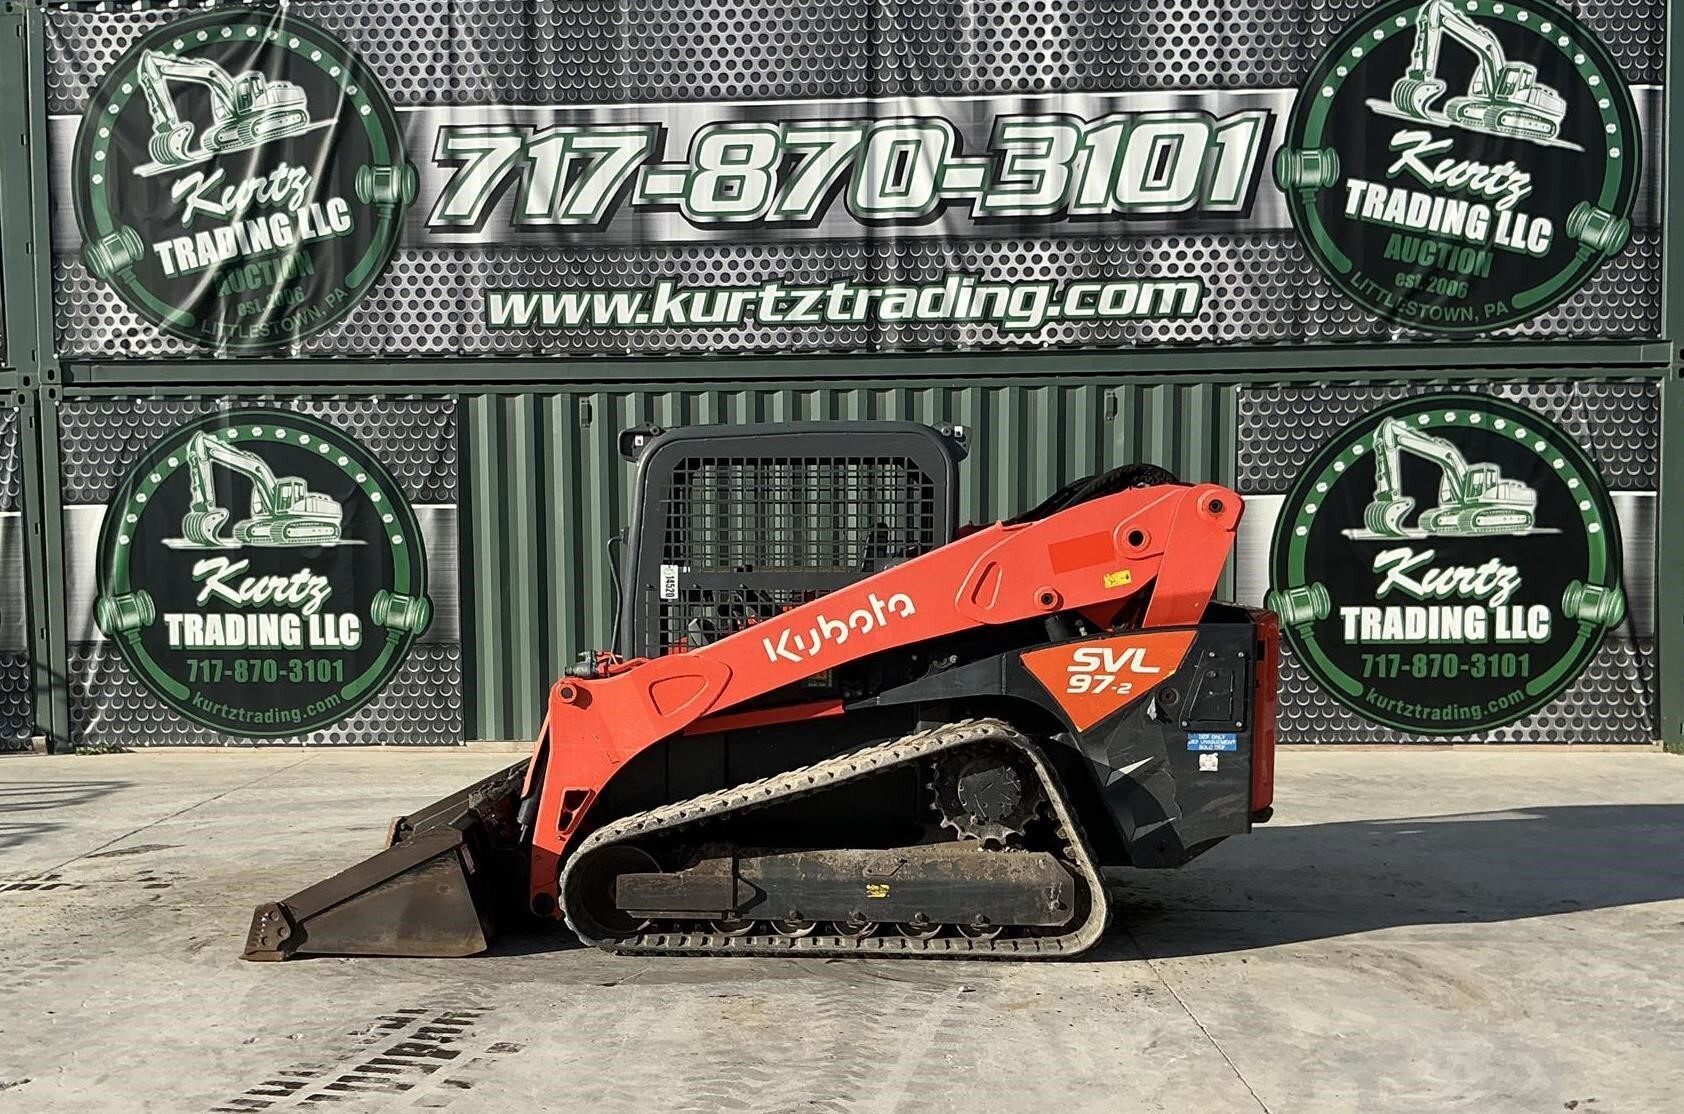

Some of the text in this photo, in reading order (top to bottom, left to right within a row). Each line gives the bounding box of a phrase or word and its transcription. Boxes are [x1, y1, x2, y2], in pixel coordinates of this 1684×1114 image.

[426, 111, 1270, 228] 717-870-3101
[1387, 130, 1533, 211] Kurtz
[171, 162, 312, 225] Kurtz
[1346, 178, 1552, 254] TRADING LLC
[153, 198, 352, 276] TRADING LLC
[1383, 233, 1494, 278] AUCTION
[218, 250, 315, 297] AUCTION
[1425, 277, 1470, 299] 2006
[266, 286, 305, 308] 006
[325, 287, 349, 308] PA
[486, 272, 1202, 331] www.kurtztrading.com
[1484, 301, 1509, 318] PA
[192, 556, 331, 615] Kurtz
[1373, 547, 1522, 606] Kurtz
[164, 613, 361, 649] TRADING LLC
[762, 593, 916, 663] Kubota
[1341, 605, 1552, 643] TRADING LLC
[186, 659, 345, 683] 717-870-3101
[1067, 647, 1161, 674] SVL
[1360, 653, 1531, 678] 717-870-3101
[1066, 673, 1133, 695] 97-2
[192, 693, 341, 724] kurtztrading.com
[1365, 689, 1525, 721] kurtztrading.com
